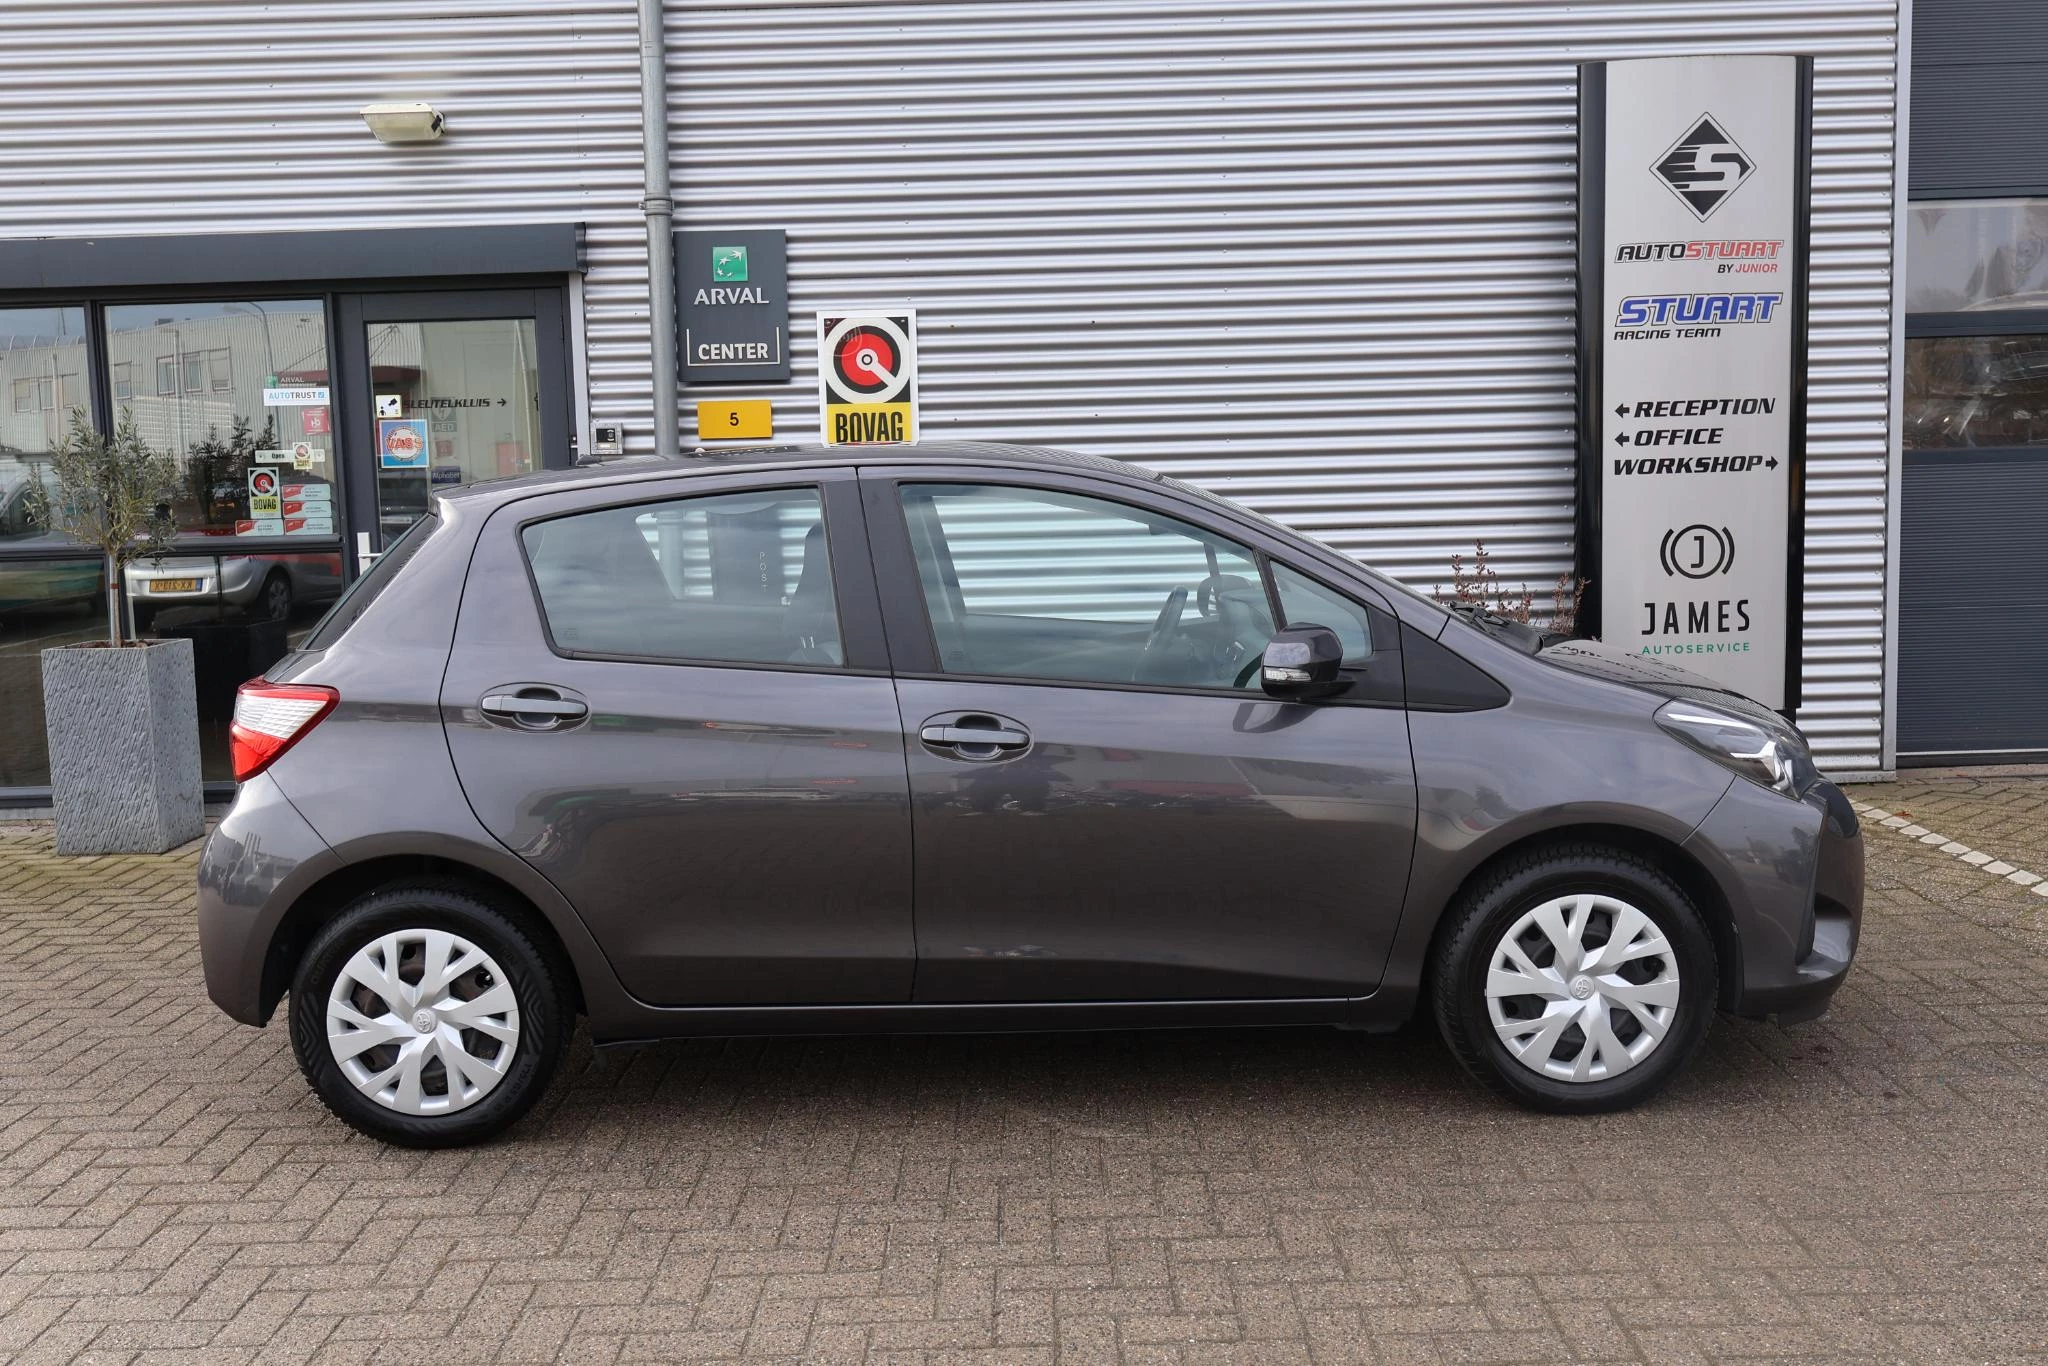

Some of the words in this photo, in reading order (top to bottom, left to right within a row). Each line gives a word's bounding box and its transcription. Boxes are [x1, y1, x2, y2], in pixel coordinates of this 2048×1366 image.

[1615, 241, 1783, 262] AUTOSTUART
[1717, 264, 1734, 274] BY
[1735, 263, 1778, 273] JUNIOR
[694, 287, 770, 305] ARVAL
[1616, 293, 1783, 327] STUART
[1614, 329, 1671, 341] RACING
[1676, 328, 1721, 338] TEAM
[698, 342, 769, 360] CENTER
[268, 391, 317, 400] AUTOTRUST
[1634, 398, 1775, 418] RECEPTION
[433, 423, 455, 432] AED
[729, 412, 739, 427] 5
[835, 411, 904, 443] BOVAG
[1634, 428, 1724, 446] OFFICE
[1614, 455, 1763, 475] WORKSHOP
[253, 498, 277, 510] BOVAG
[1641, 599, 1750, 635] JAMES
[1642, 642, 1750, 655] AUTOSERVICE
